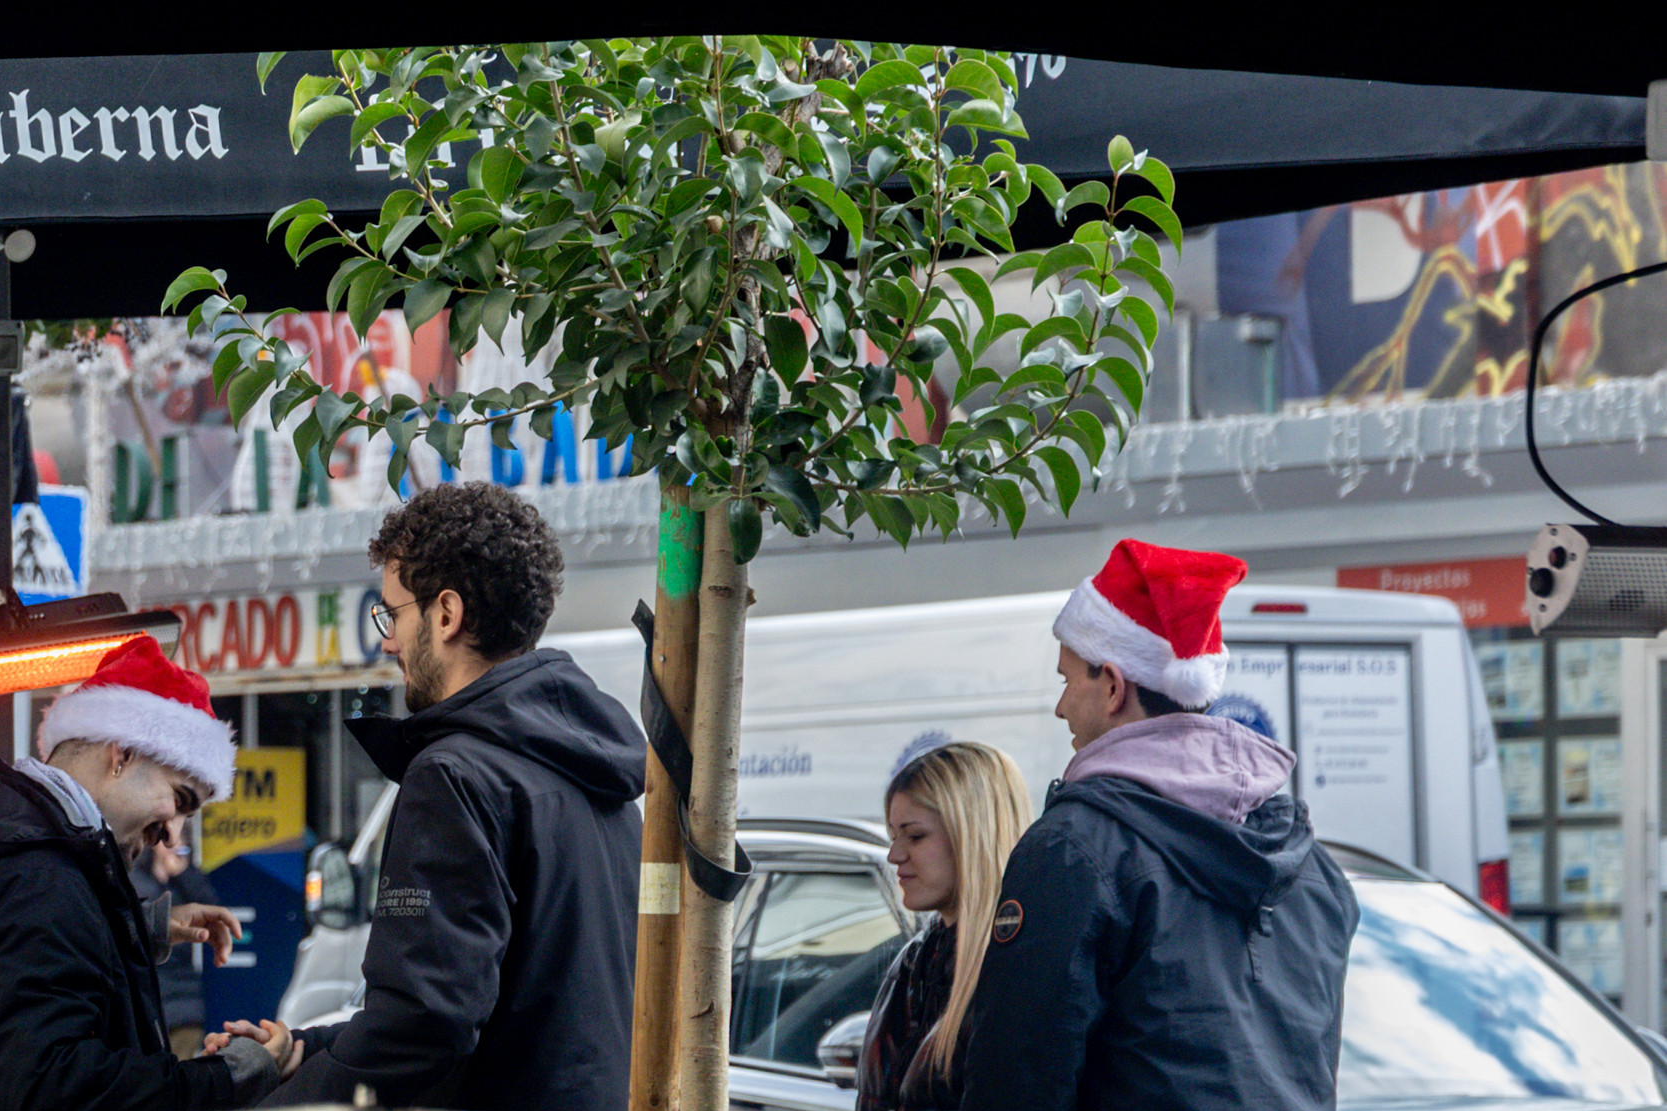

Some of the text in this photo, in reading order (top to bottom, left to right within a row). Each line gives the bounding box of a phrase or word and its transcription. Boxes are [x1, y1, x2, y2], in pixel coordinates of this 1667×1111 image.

[1380, 569, 1472, 592] Proyectos
[138, 594, 303, 673] RCADO
[738, 743, 813, 778] ntación
